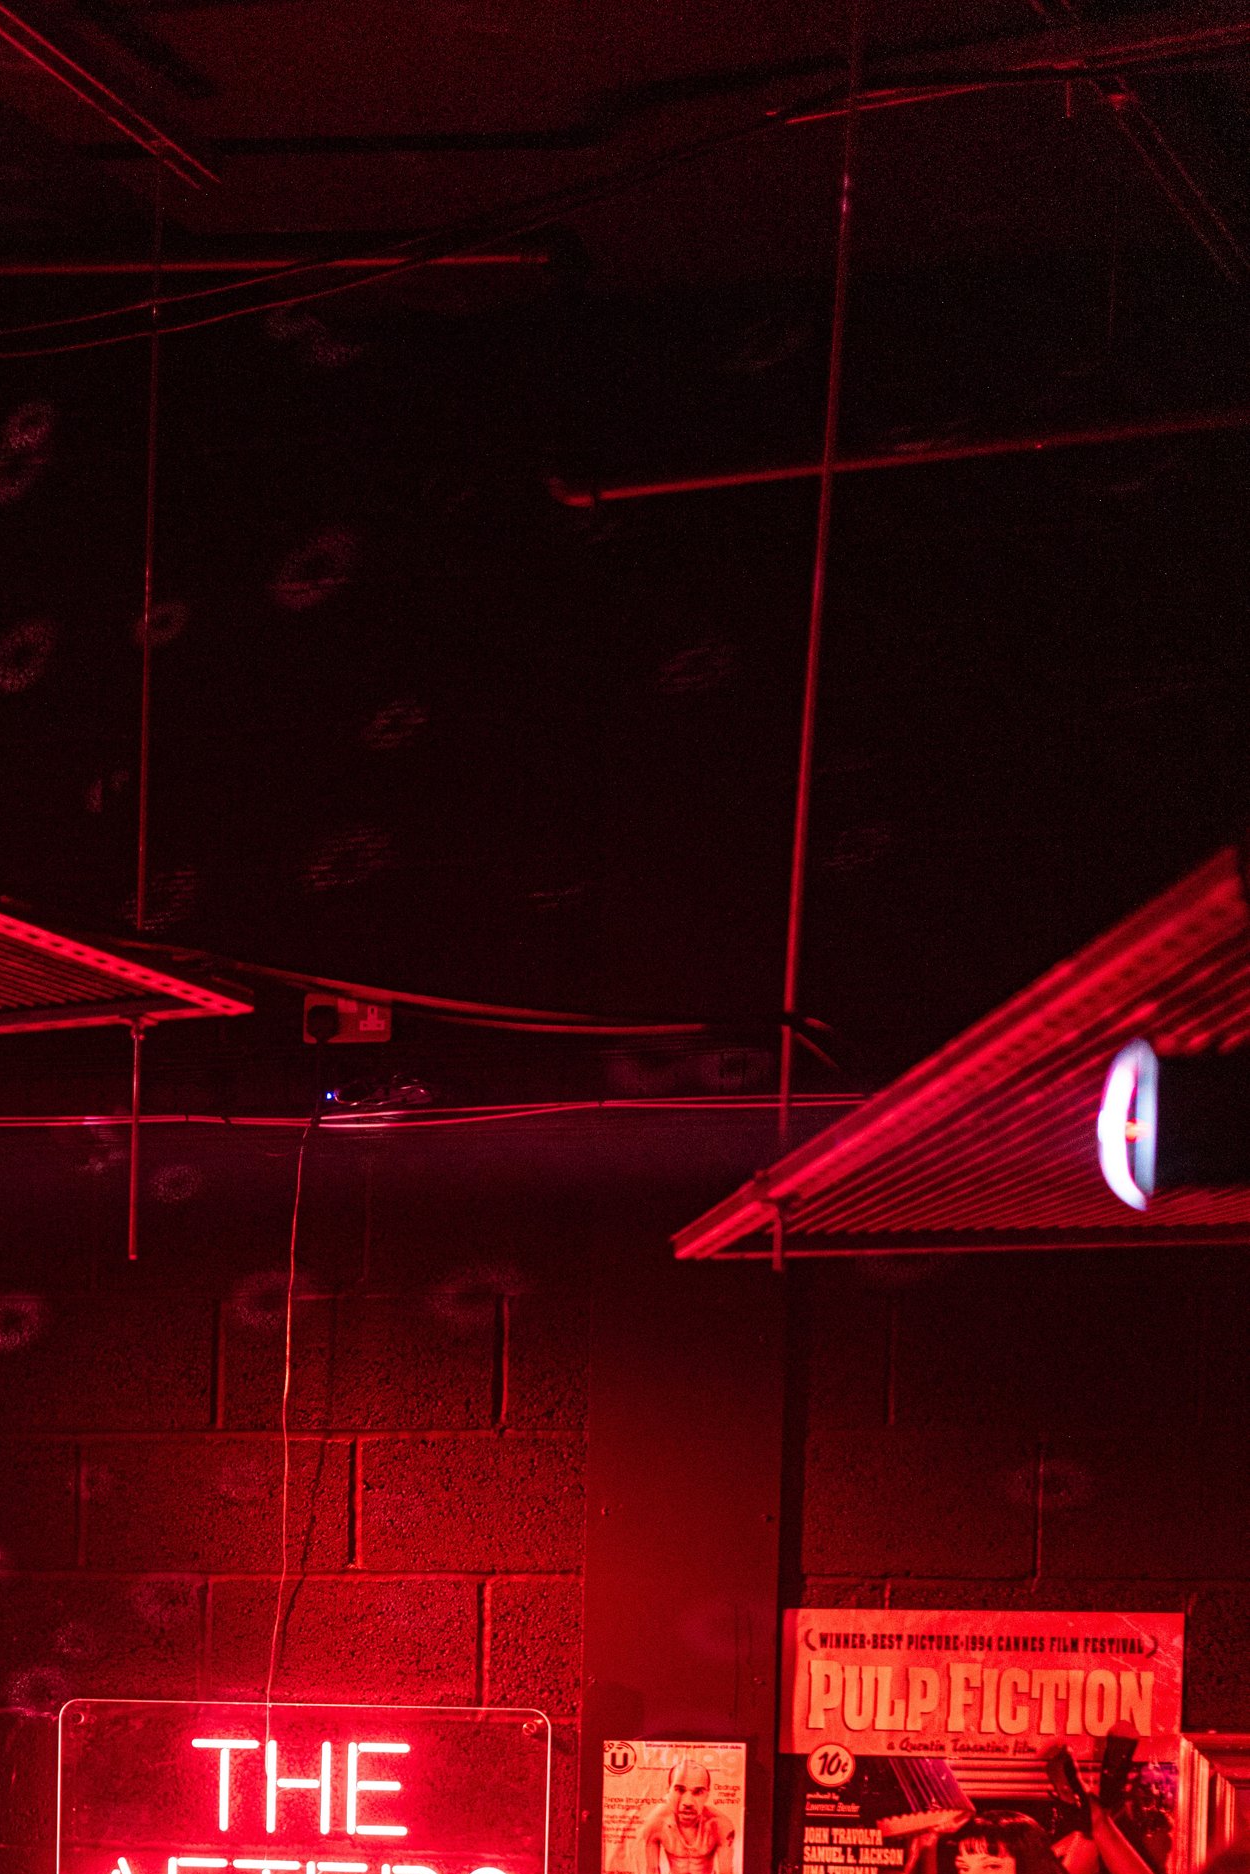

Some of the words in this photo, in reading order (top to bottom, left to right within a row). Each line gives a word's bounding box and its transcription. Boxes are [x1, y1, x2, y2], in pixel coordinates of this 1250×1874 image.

[997, 1636, 1045, 1652] CANNES
[1051, 1637, 1079, 1652] FILM
[1084, 1638, 1144, 1654] FESTIVAL
[807, 1660, 941, 1732] PULP
[946, 1662, 1155, 1737] FICTION
[900, 1737, 945, 1752] Quentin
[951, 1738, 1010, 1753] Tarantino
[1013, 1740, 1037, 1756] film
[191, 1738, 411, 1836] THE
[804, 1827, 830, 1844] JOHN
[831, 1828, 883, 1846] TRAVOLTA
[803, 1845, 845, 1863] SAMUEL
[858, 1848, 904, 1866] JACKSON
